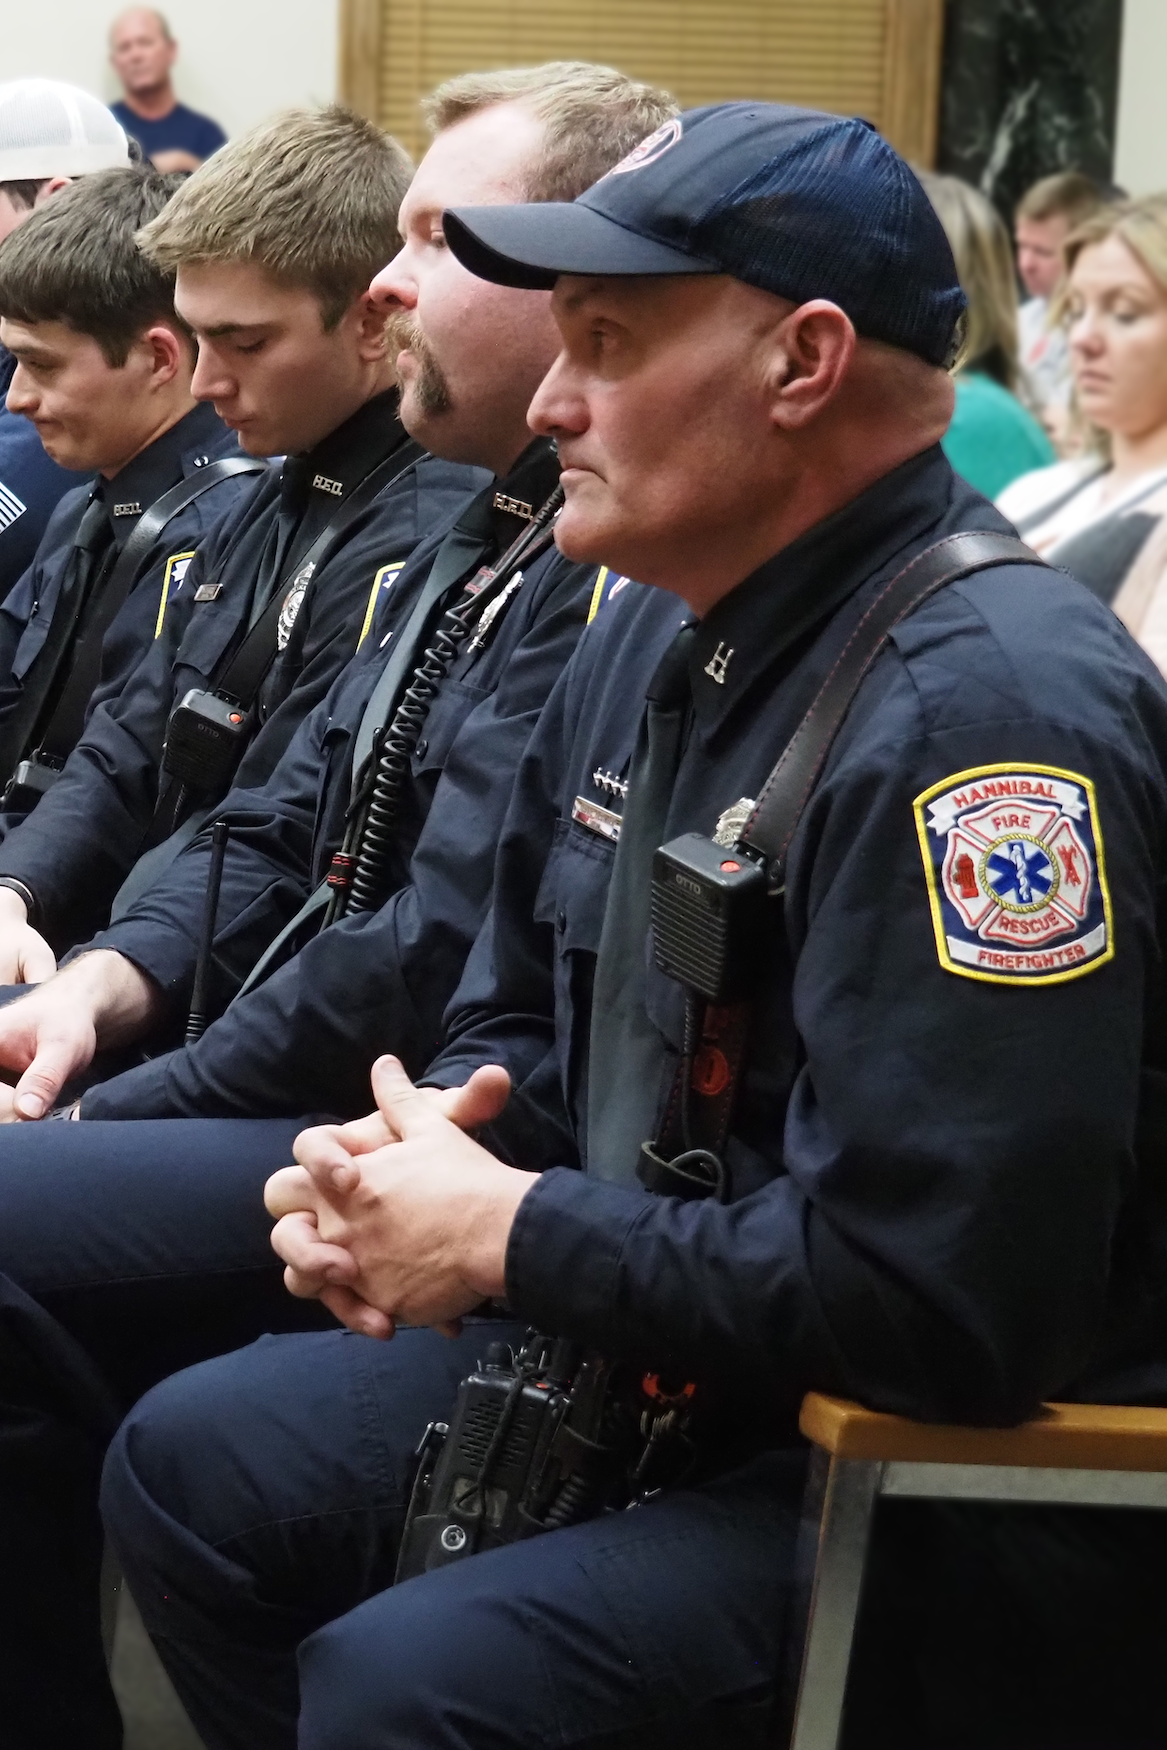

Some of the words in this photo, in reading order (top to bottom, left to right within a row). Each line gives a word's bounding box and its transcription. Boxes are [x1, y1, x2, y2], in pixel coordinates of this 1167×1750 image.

[952, 780, 1058, 809] HANNIBAL
[991, 814, 1032, 832] FIRE
[675, 873, 701, 895] OTTO
[997, 911, 1060, 935] RESCUE
[977, 944, 1087, 970] FIREFIGHTER
